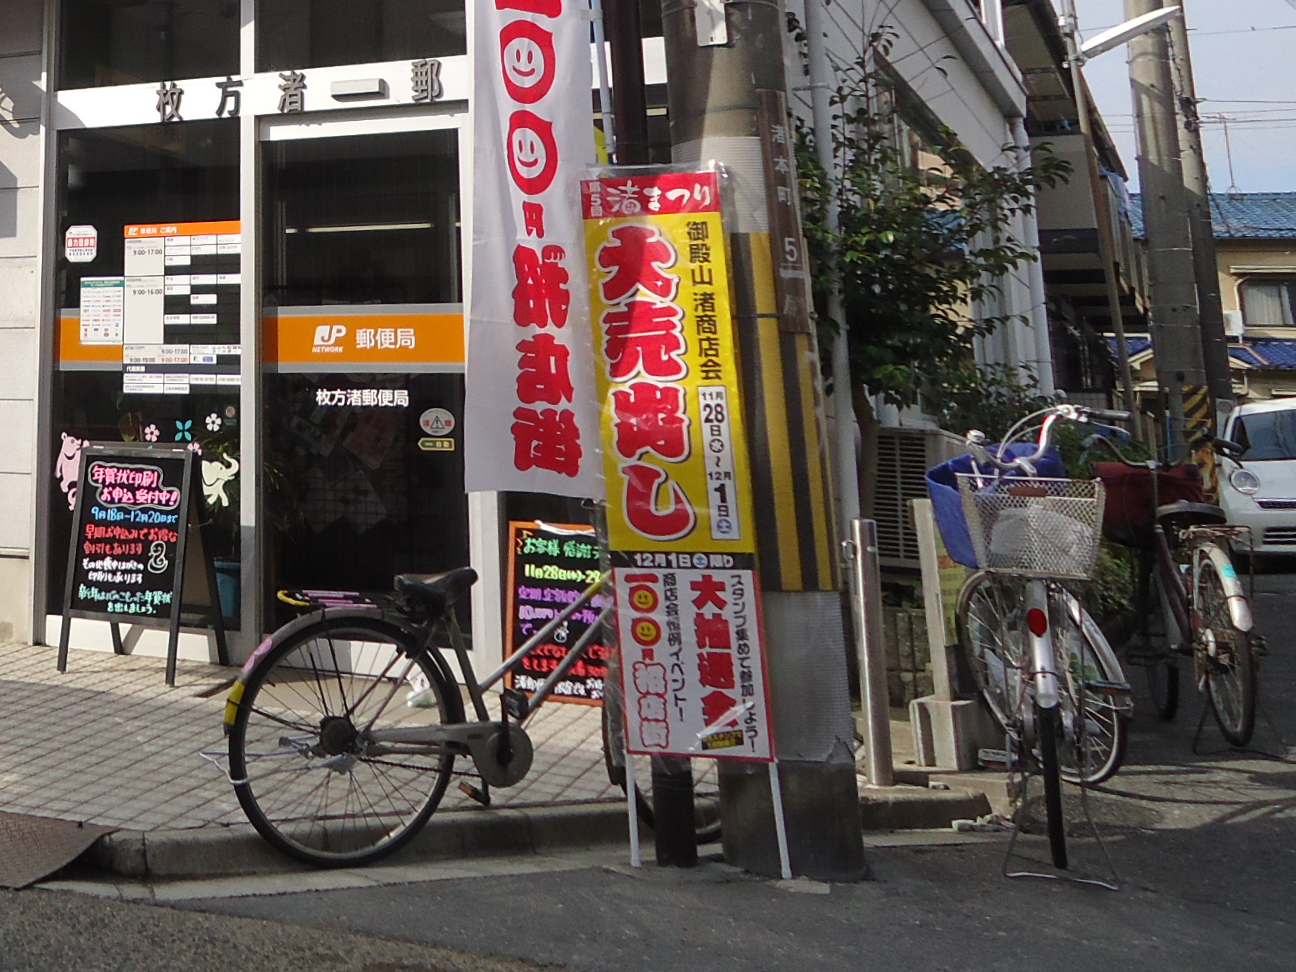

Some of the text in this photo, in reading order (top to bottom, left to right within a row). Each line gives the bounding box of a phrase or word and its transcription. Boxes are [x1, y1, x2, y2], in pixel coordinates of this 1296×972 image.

[770, 124, 792, 206] 渚本町
[588, 181, 604, 217] 第5回
[606, 179, 712, 215] 渚まつり
[784, 237, 798, 262] 5
[686, 221, 723, 380] 御殿山 渚商店会
[312, 345, 344, 354] NETWORK
[313, 324, 347, 346] JP
[355, 327, 416, 350] 郵便局
[595, 222, 697, 541] 大売出し
[315, 388, 410, 408] 枚方渚郵便局
[91, 465, 159, 488] 年賀状印刷
[690, 573, 739, 730] 大抽選会
